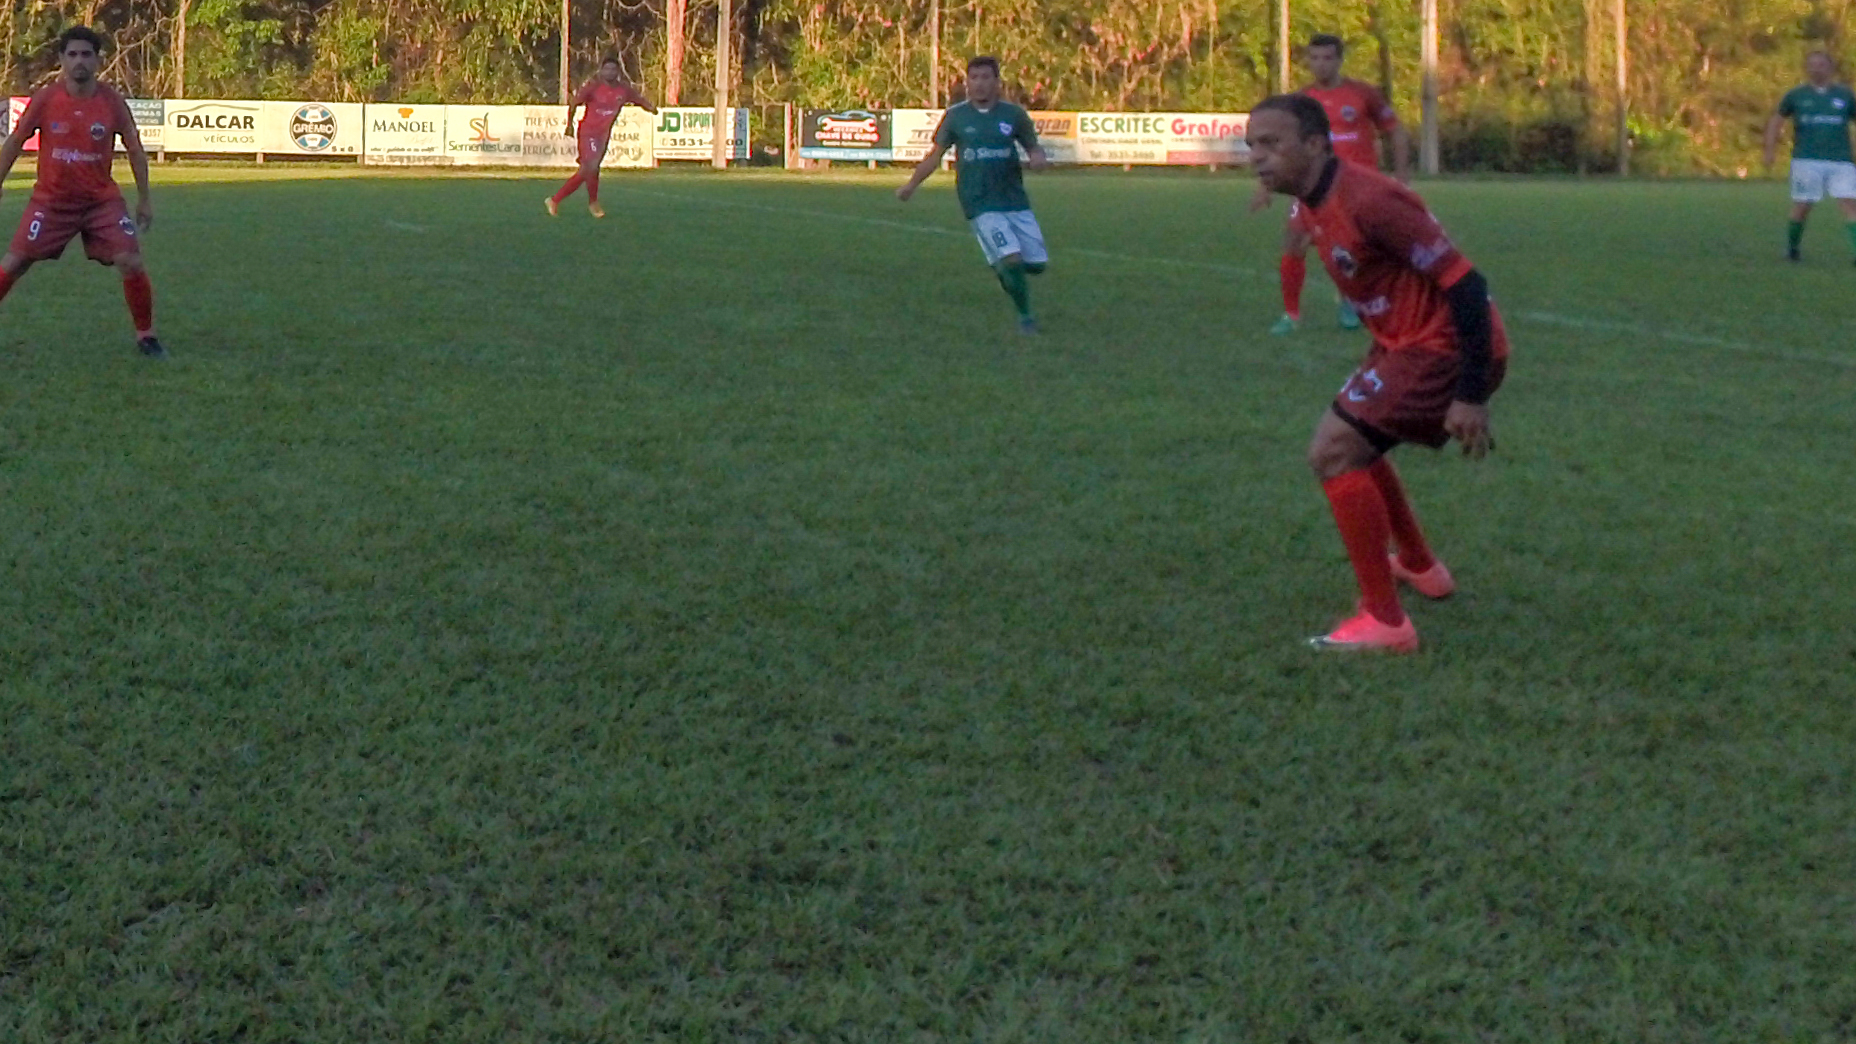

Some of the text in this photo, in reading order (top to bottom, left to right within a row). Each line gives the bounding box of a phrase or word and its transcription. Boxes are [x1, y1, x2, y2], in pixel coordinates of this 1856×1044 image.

[177, 115, 255, 129] DALCAR
[373, 119, 436, 132] MANOEL
[657, 112, 681, 132] JD
[1080, 117, 1165, 133] ESCRITEC
[204, 133, 255, 144] VEÍCULOS
[28, 219, 41, 241] 9
